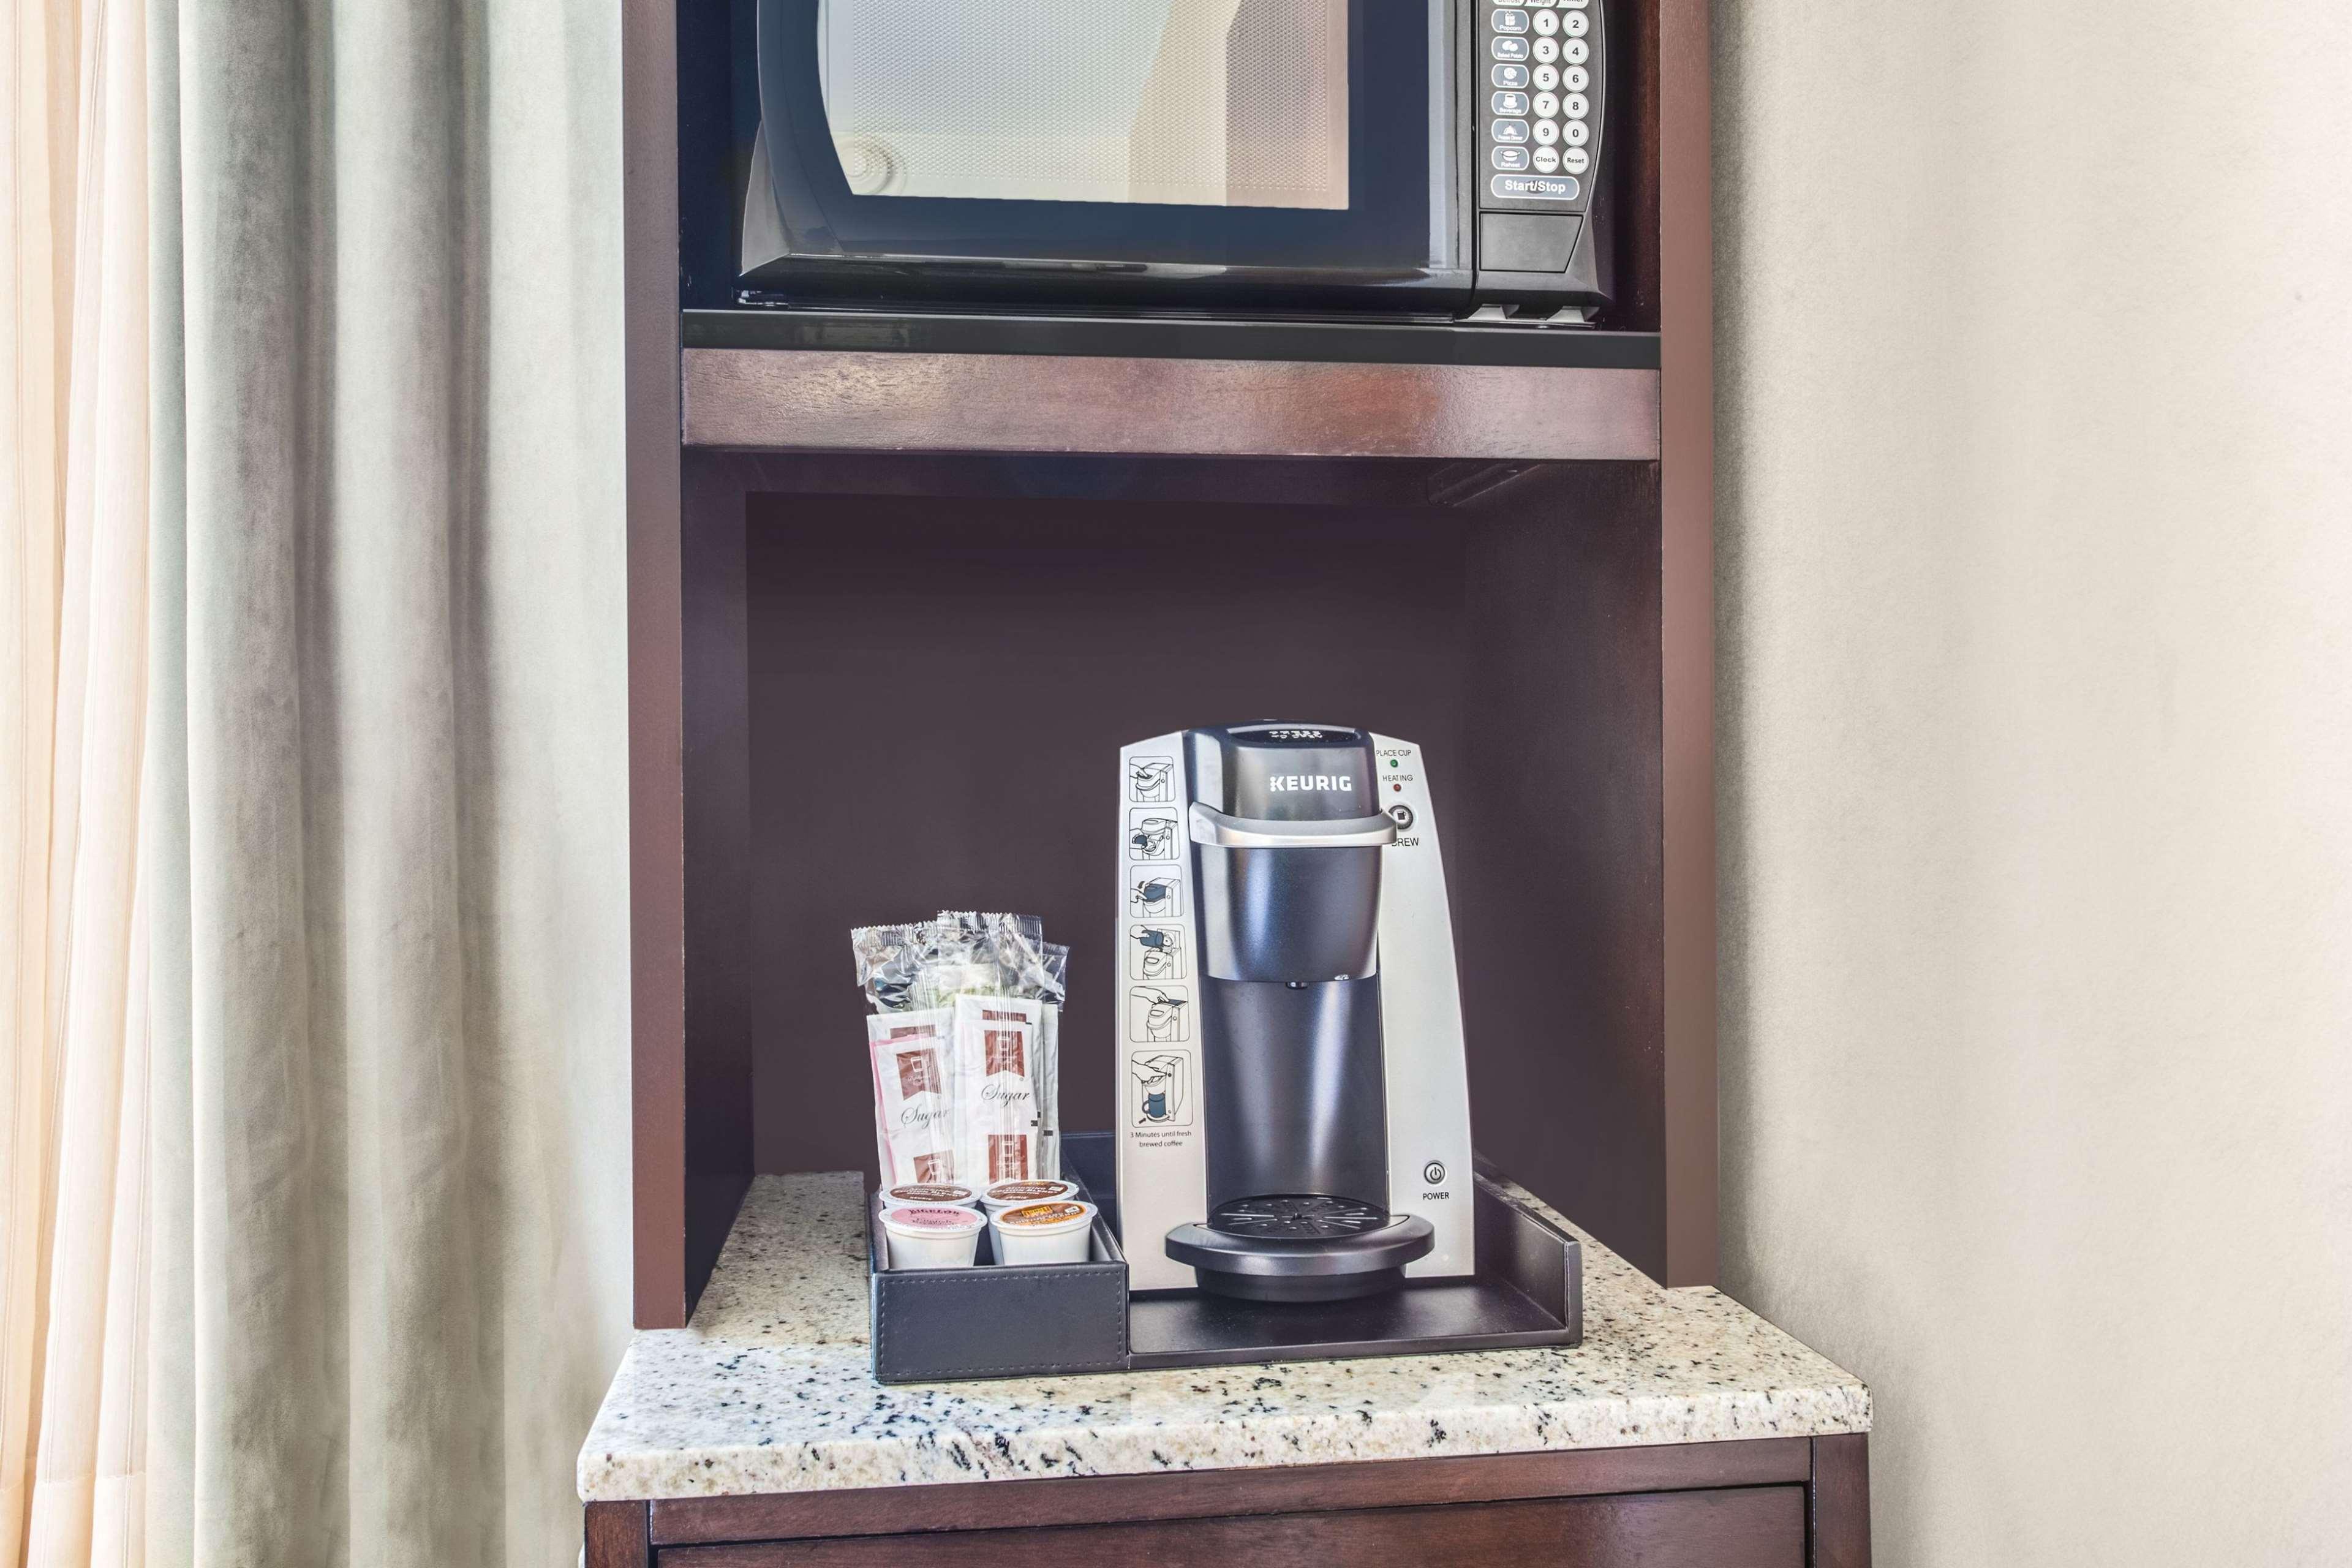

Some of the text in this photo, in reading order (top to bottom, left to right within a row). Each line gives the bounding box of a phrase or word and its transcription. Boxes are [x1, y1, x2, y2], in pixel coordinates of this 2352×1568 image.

[1544, 18, 1549, 27] 1
[1572, 20, 1579, 28] 2
[1542, 46, 1549, 55] 3
[1572, 47, 1579, 56] 4
[1572, 74, 1579, 83] 6
[1542, 100, 1550, 109] 7
[1572, 102, 1579, 110] 8
[1542, 127, 1550, 136] 9
[1572, 129, 1579, 137] 0
[1504, 179, 1566, 194] Start/Stop
[1270, 775, 1352, 792] KEURIG
[981, 1084, 1030, 1107] Sugar
[900, 1103, 951, 1129] Sugar
[1422, 1192, 1450, 1200] POWER
